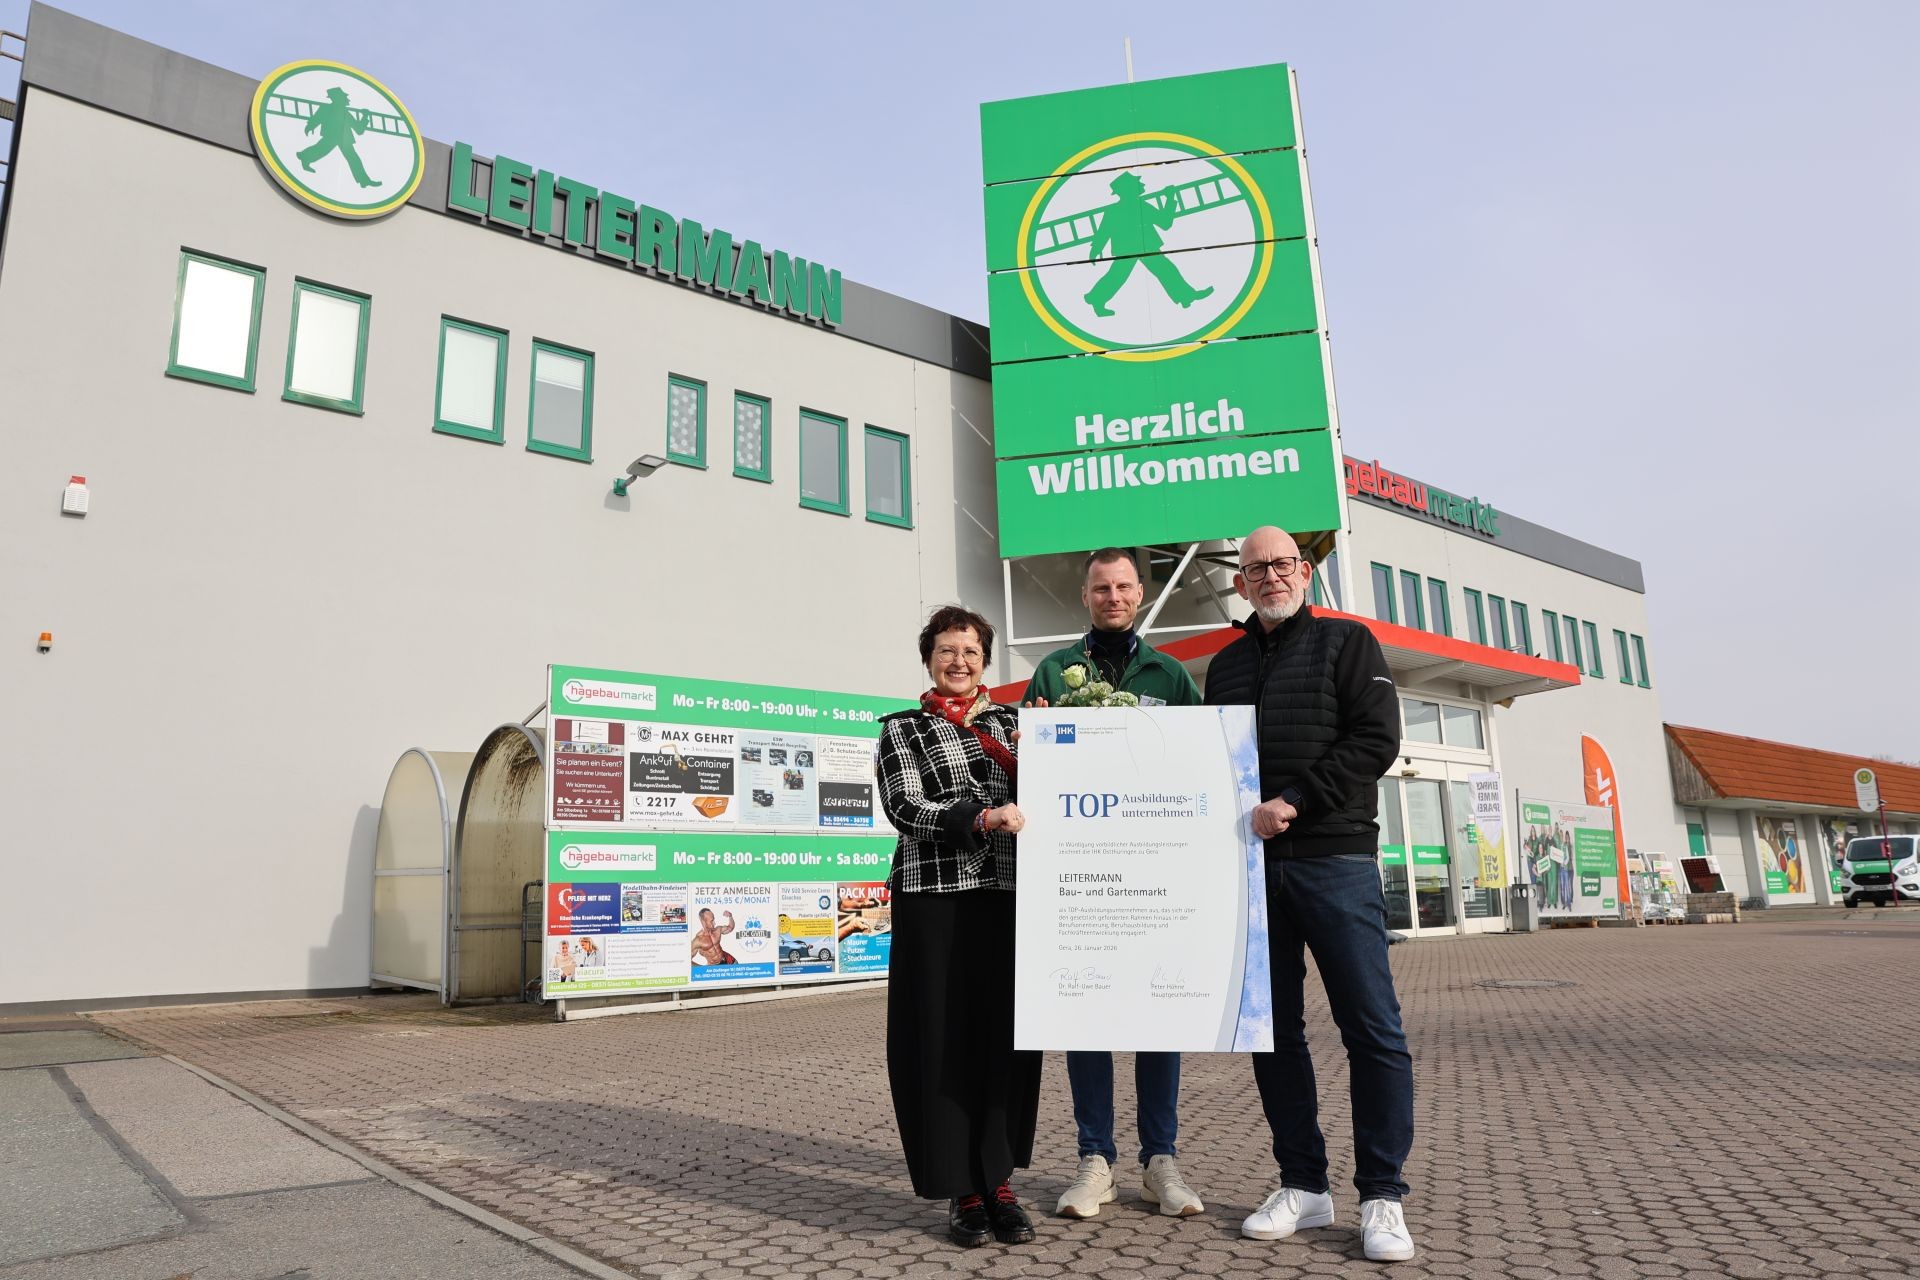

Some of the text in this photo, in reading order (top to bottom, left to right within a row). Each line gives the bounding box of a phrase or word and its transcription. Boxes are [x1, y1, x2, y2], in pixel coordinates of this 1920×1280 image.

[448, 140, 842, 328] LEITERMANN
[1075, 398, 1244, 446] Herzlich
[1028, 448, 1299, 496] Willkommen
[1343, 459, 1502, 536] gebaumarkt
[571, 686, 654, 702] hagebaumarkt
[673, 694, 694, 707] Mo
[706, 697, 719, 710] Fr
[722, 698, 749, 712] 8:00
[761, 702, 793, 716] 19:00
[796, 704, 818, 718] Uhr
[833, 708, 846, 720] Sa
[849, 710, 873, 722] 8:00
[662, 730, 734, 744] MAX GEHRT
[640, 755, 672, 766] Ankauf
[686, 757, 730, 769] Container
[647, 797, 676, 807] 2217
[1122, 793, 1193, 804] Ausbildungs-
[1059, 794, 1119, 818] TOP
[1122, 808, 1193, 818] unternehmen
[569, 851, 653, 864] hagebaumarkt
[674, 852, 694, 864] Mo
[707, 852, 720, 865] Fr
[723, 852, 752, 865] 8:00
[764, 853, 797, 865] 19:00
[800, 852, 822, 865] Uhr
[836, 853, 850, 865] Sa
[853, 853, 878, 865] 8:00
[1059, 874, 1122, 882] LEITERMANN
[695, 887, 720, 895] JETZT
[840, 888, 886, 898] PACK MIT
[1059, 887, 1167, 896] Bau- und Gartenmarkt
